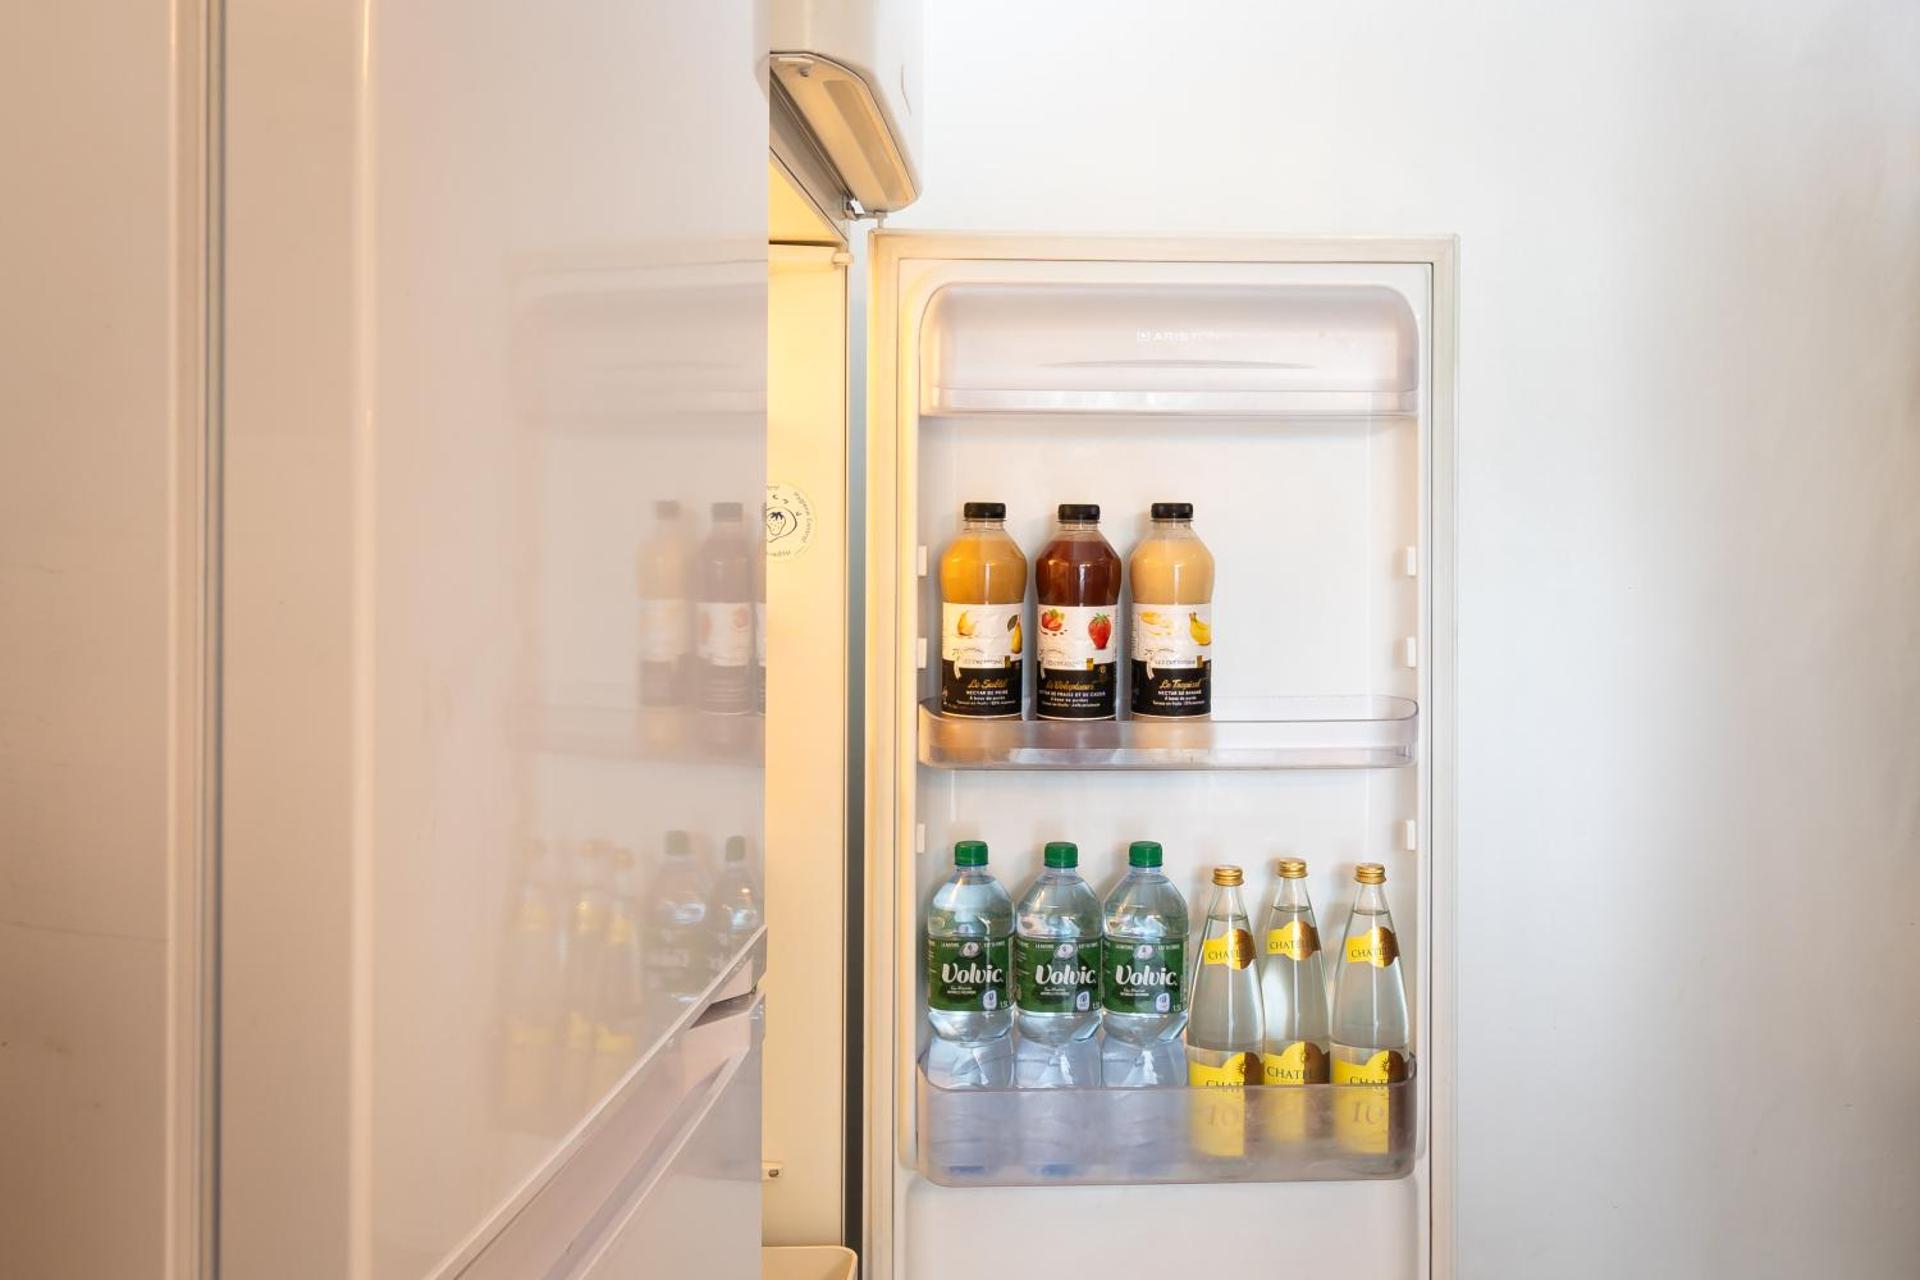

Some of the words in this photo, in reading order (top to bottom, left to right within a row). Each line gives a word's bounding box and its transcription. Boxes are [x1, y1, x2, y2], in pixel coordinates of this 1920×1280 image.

[942, 962, 1004, 984] Volvic
[1035, 963, 1097, 985] Volvic
[1115, 965, 1178, 987] Volvic
